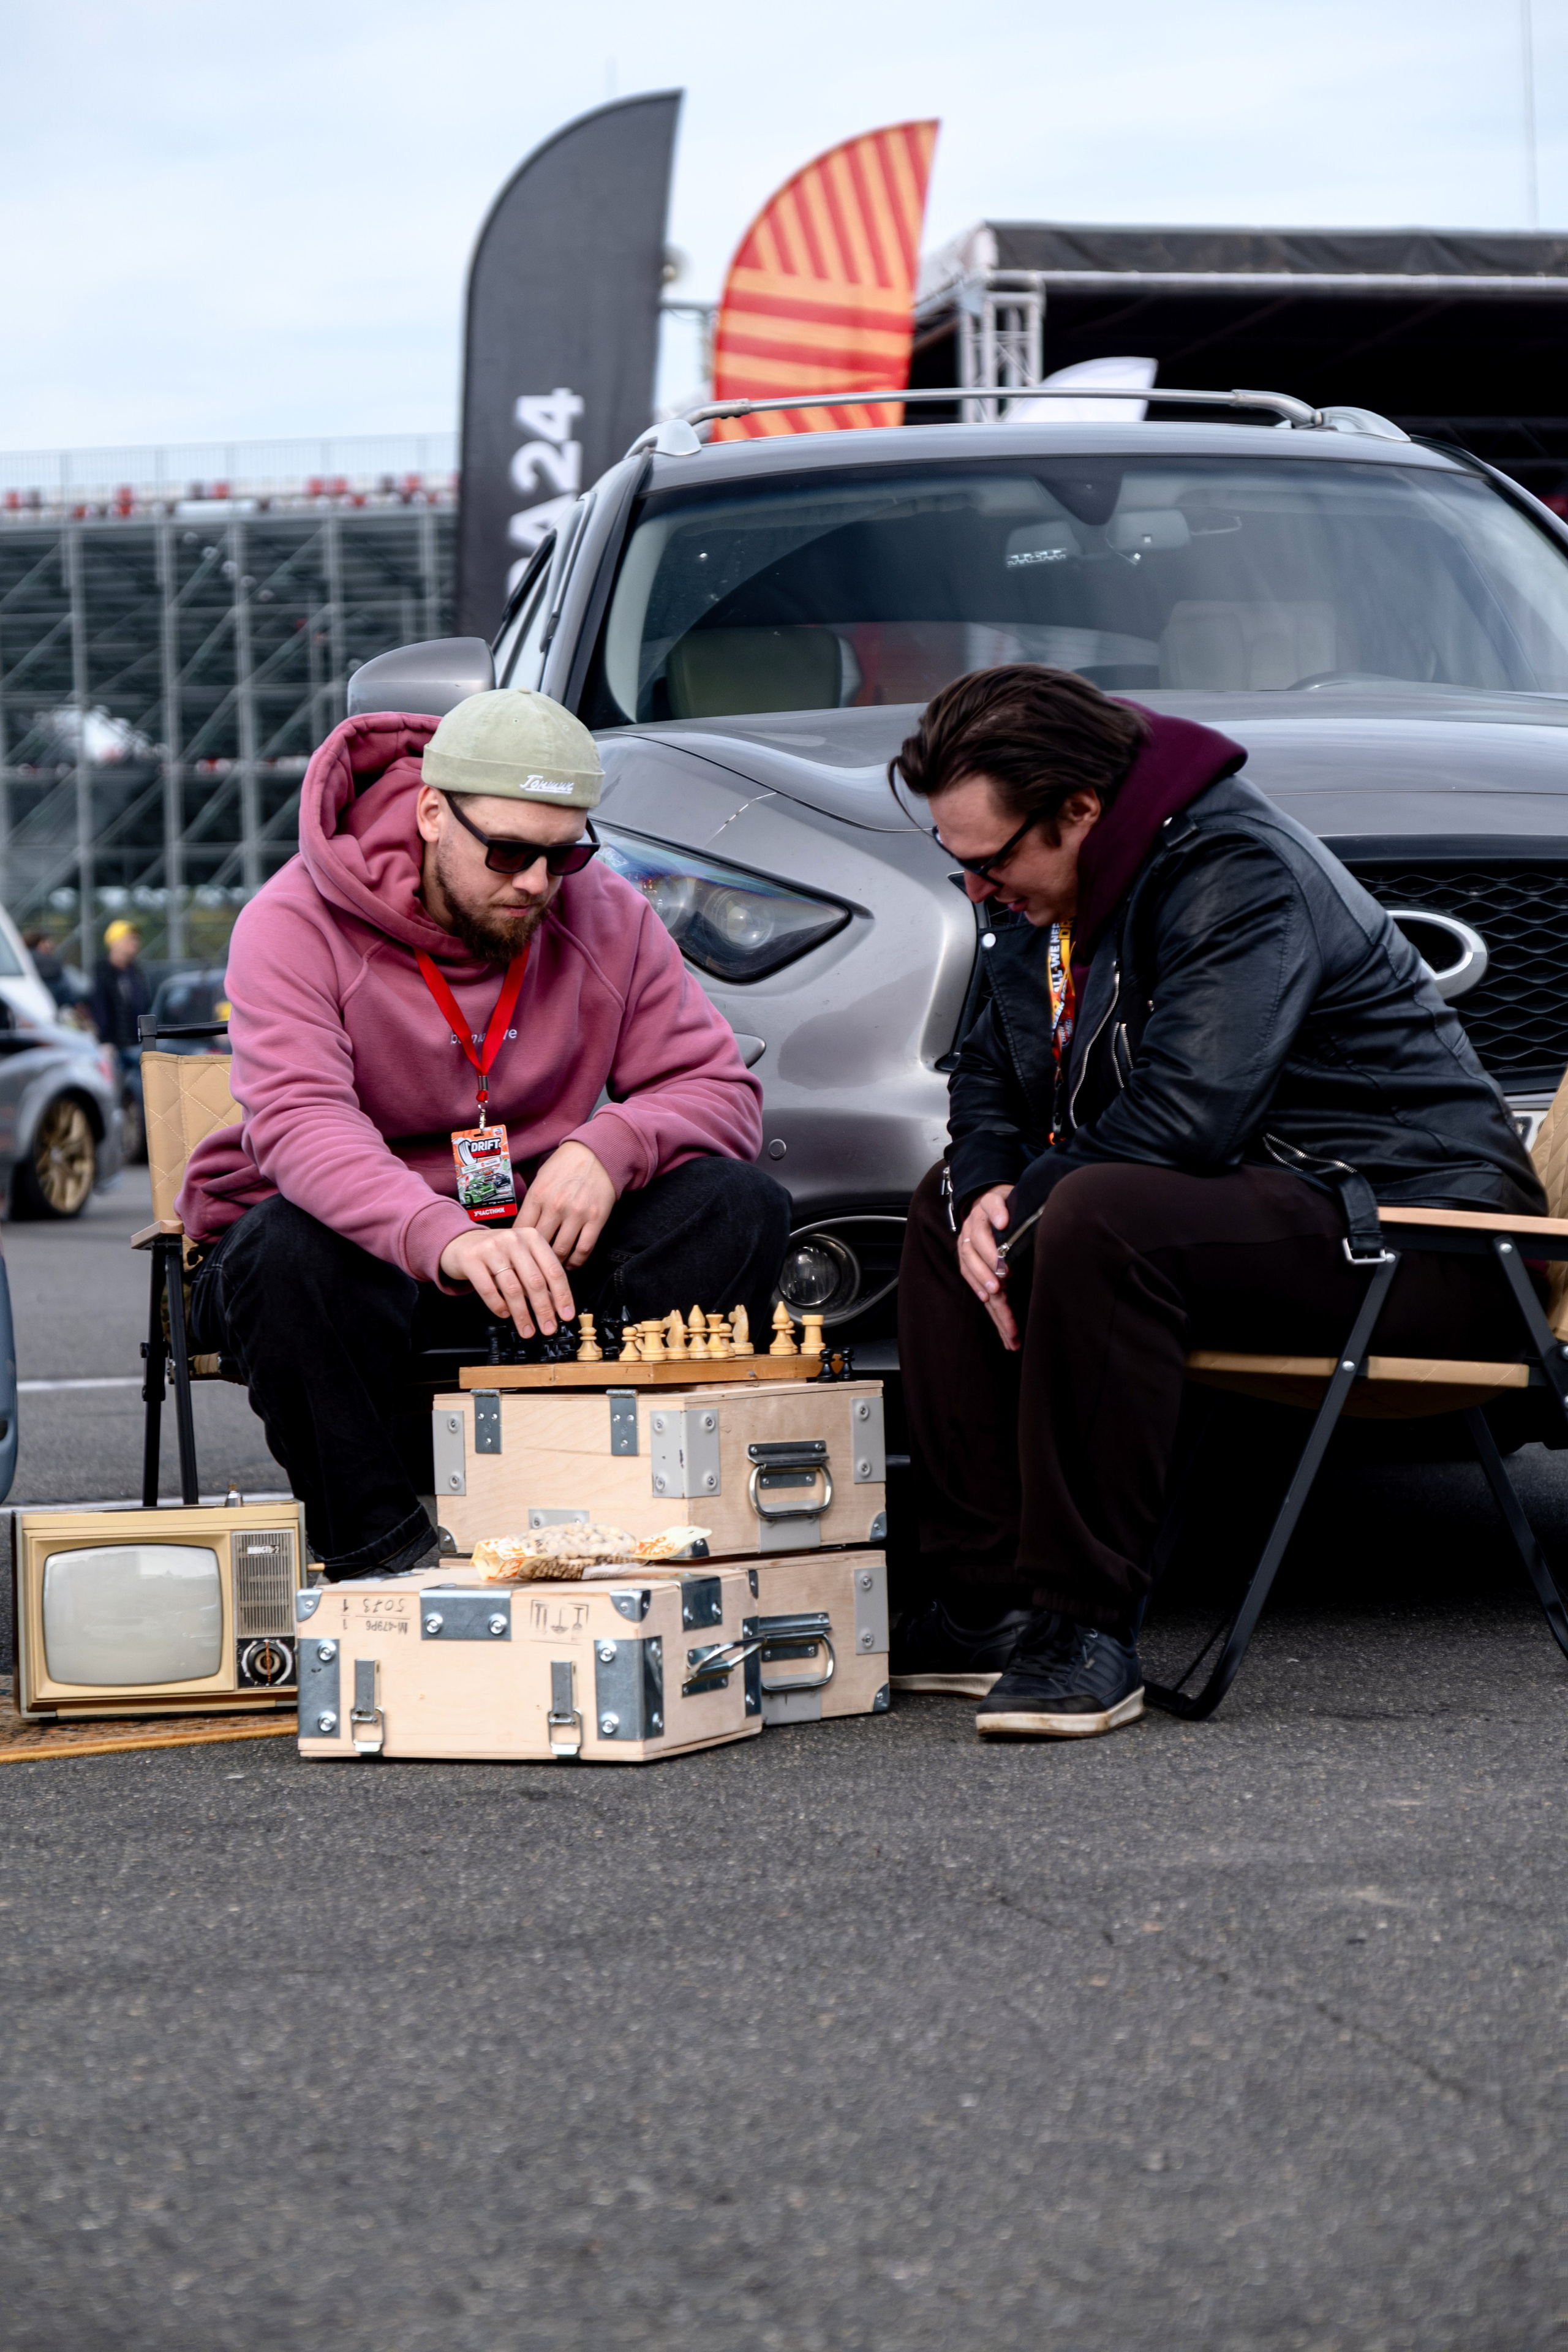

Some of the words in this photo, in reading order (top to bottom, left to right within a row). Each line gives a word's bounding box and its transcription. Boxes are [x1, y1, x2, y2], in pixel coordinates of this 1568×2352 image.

[508, 386, 586, 603] A24
[1050, 922, 1060, 943] NEE
[1050, 944, 1060, 968] WE
[471, 1139, 500, 1152] DRIFT
[473, 1207, 505, 1217] УЧАСТНИК
